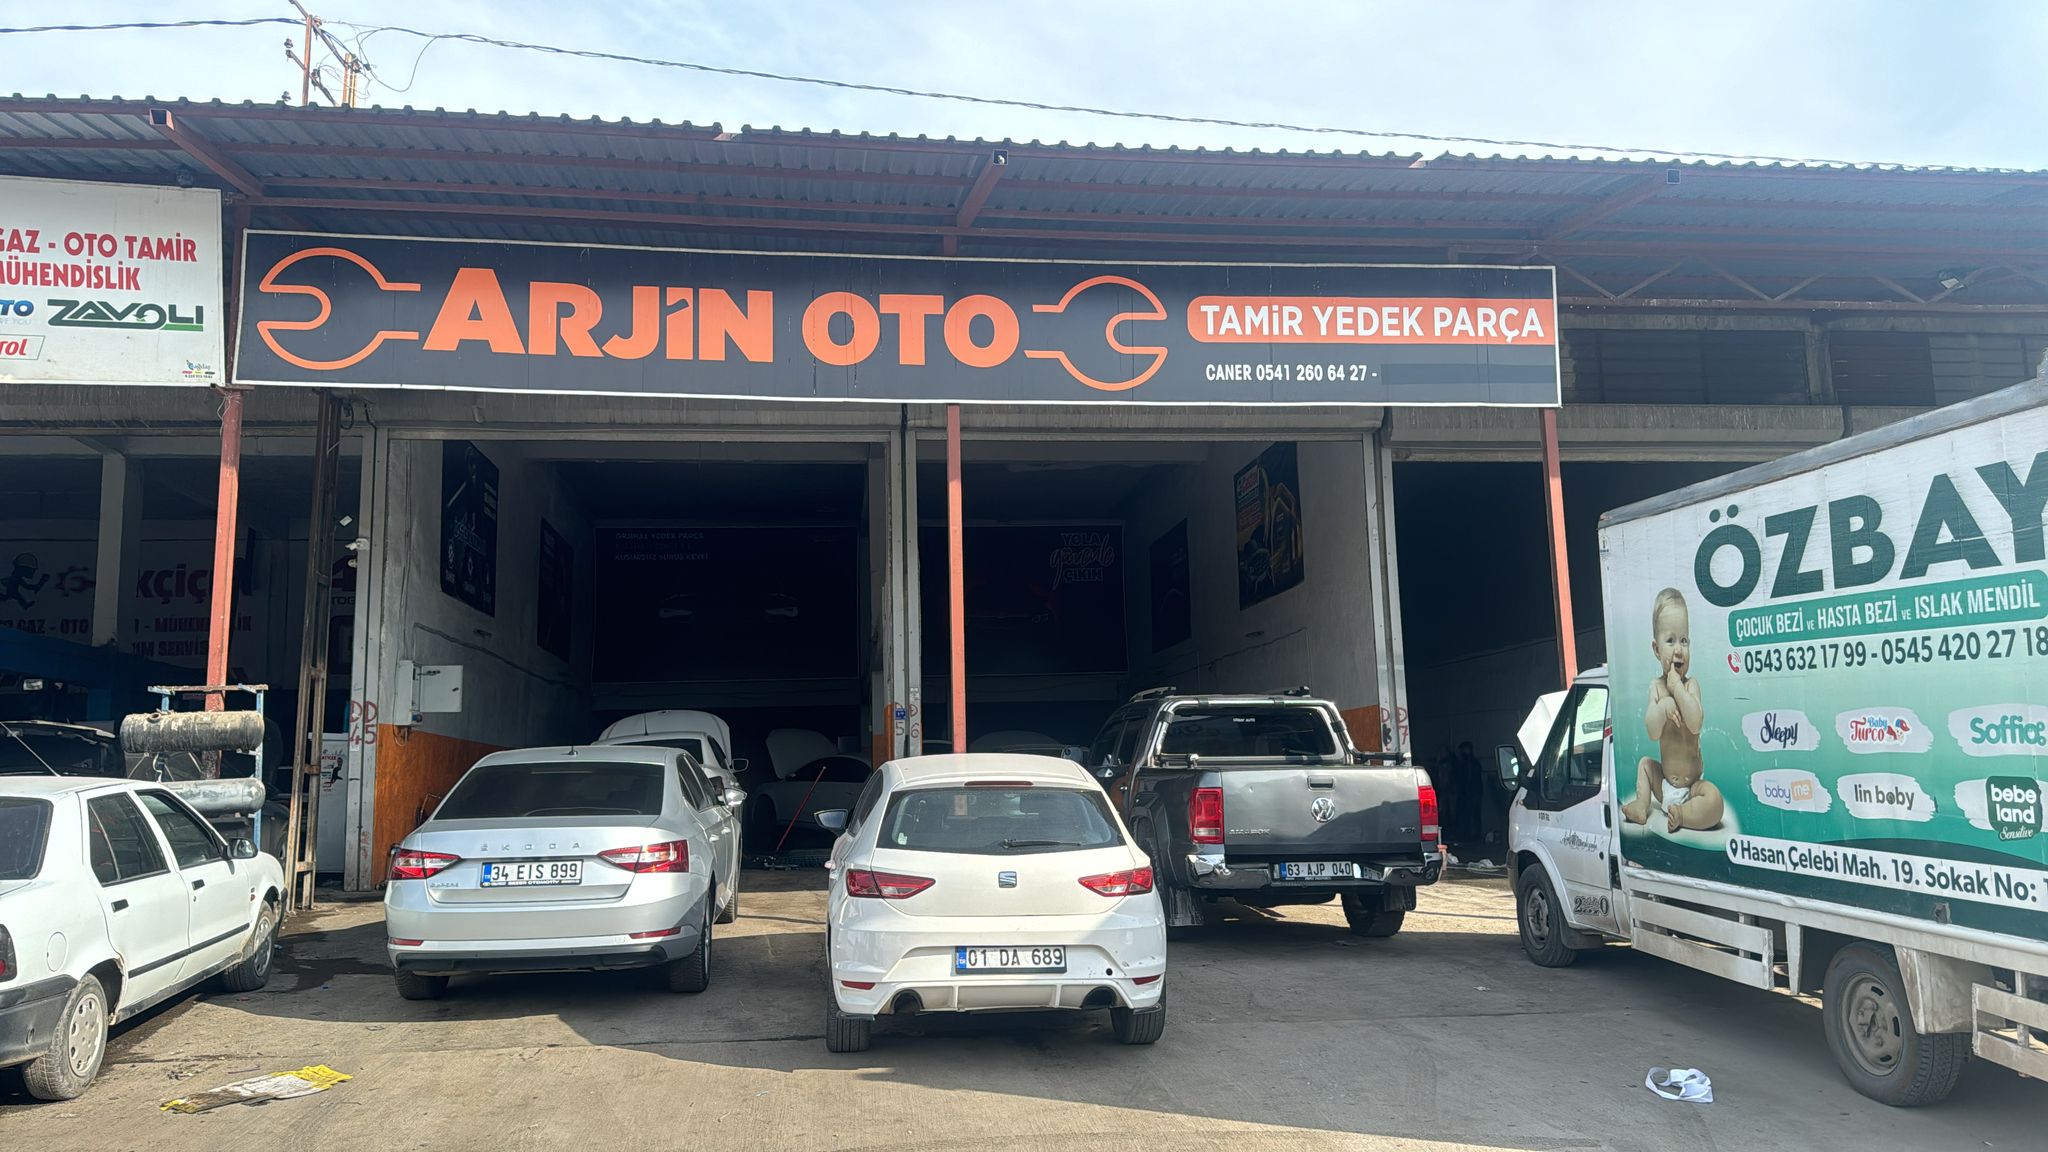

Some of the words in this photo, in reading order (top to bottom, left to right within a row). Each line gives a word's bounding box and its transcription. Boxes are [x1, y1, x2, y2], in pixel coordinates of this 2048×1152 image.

[0, 228, 40, 254] AZ
[64, 231, 118, 258] OTO
[125, 232, 197, 263] TAMİR
[0, 255, 141, 291] ÜHENDİSLİK
[48, 298, 204, 331] ZAVOLI
[1312, 305, 1424, 338] YEDEK
[1433, 307, 1545, 343] PARÇA
[802, 291, 1020, 368] OTO
[1206, 363, 1252, 381] CANER
[1256, 363, 1290, 381] 0541
[1296, 363, 1323, 382] 260
[1328, 364, 1345, 382] 64
[1350, 364, 1367, 382] 27
[1694, 449, 2048, 608] ÖZBAY
[1736, 615, 1773, 642] ÇOCUK
[1776, 607, 1804, 634] BEZİ
[1806, 620, 1815, 631] VE
[1817, 603, 1860, 630] HASTA
[1864, 595, 1897, 624] BEZİ
[1901, 608, 1912, 622] VE
[1915, 591, 1963, 620] ISLAK
[1967, 578, 2041, 614] MENDİL
[1744, 648, 1782, 674] 0543
[1786, 644, 1817, 671] 632
[1820, 643, 1839, 669] 17
[1844, 640, 1867, 667] 99
[1881, 635, 1933, 666] 0545
[1937, 627, 1981, 661] 420
[1986, 628, 2016, 659] 27
[2023, 624, 2048, 656] 18
[1760, 712, 1798, 749] Sleepy
[1850, 719, 1885, 743] Turco
[1867, 717, 1887, 729] Baby
[1764, 784, 1791, 804] baby
[1854, 784, 1873, 803] lin
[1990, 783, 2038, 804] bebe
[1995, 803, 2036, 824] land
[492, 866, 509, 881] 34
[517, 864, 545, 880] EIS
[550, 862, 579, 879] 899
[1287, 863, 1300, 876] 63
[1307, 862, 1326, 876] AJP
[1332, 862, 1352, 875] 040
[1740, 839, 1785, 865] Hasan
[1788, 845, 1838, 872] Çelebi
[1842, 852, 1887, 880] Mah.
[1892, 859, 1920, 886] 19.
[1924, 863, 1990, 896] Sokak
[1994, 871, 2037, 903] No:
[968, 949, 987, 967] 01
[999, 949, 1021, 967] DA
[1031, 948, 1063, 966] 689
